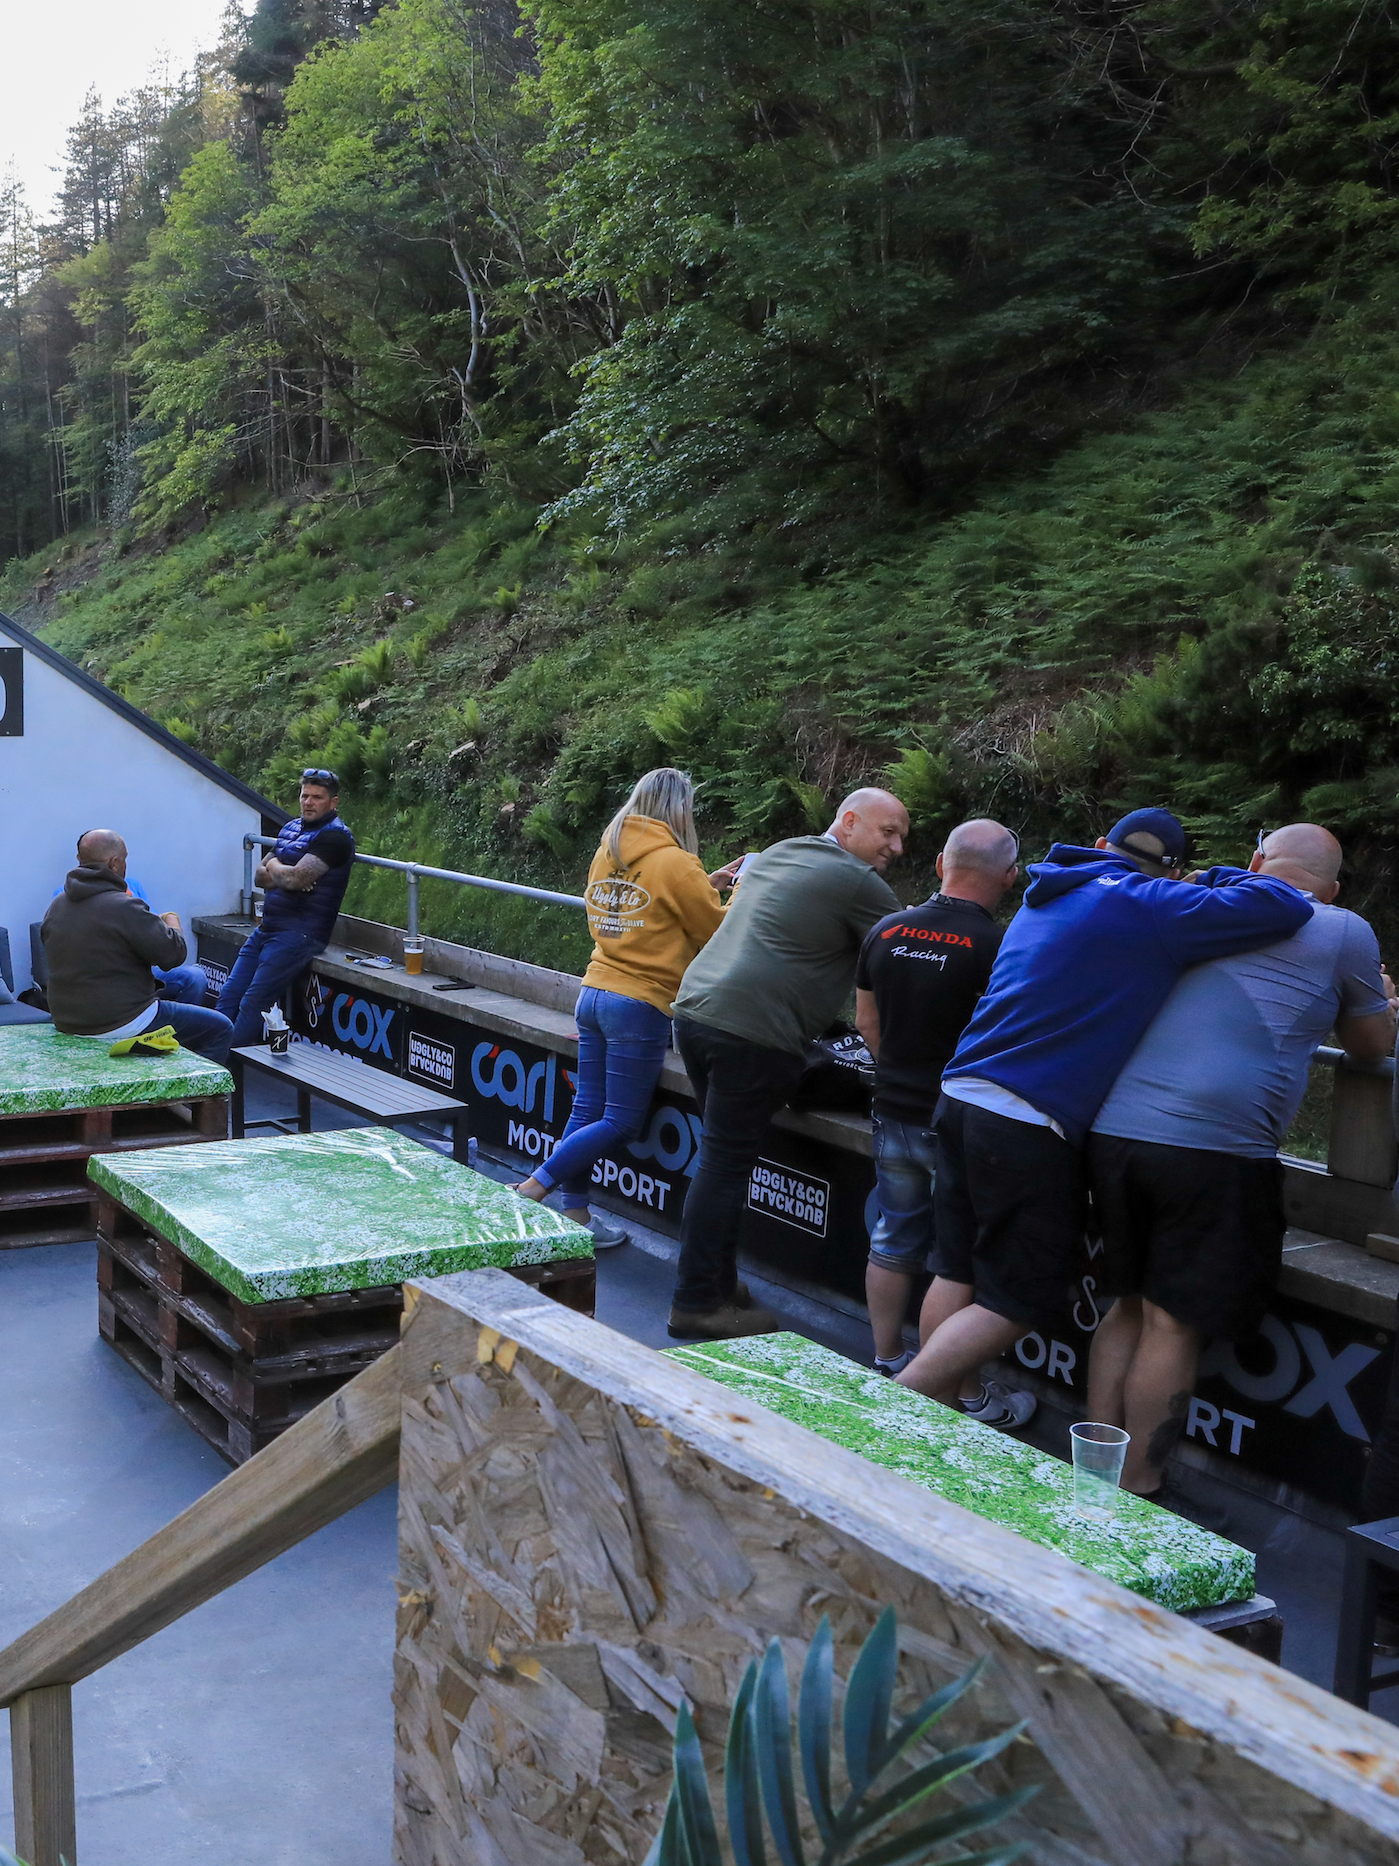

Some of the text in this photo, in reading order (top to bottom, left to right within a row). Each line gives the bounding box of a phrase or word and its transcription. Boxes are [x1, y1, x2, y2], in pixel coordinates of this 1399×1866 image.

[900, 926, 973, 948] HONDA
[891, 946, 948, 971] Racing
[411, 1040, 452, 1066] UGGLY&CO
[752, 1166, 825, 1207] UGGLY&CO
